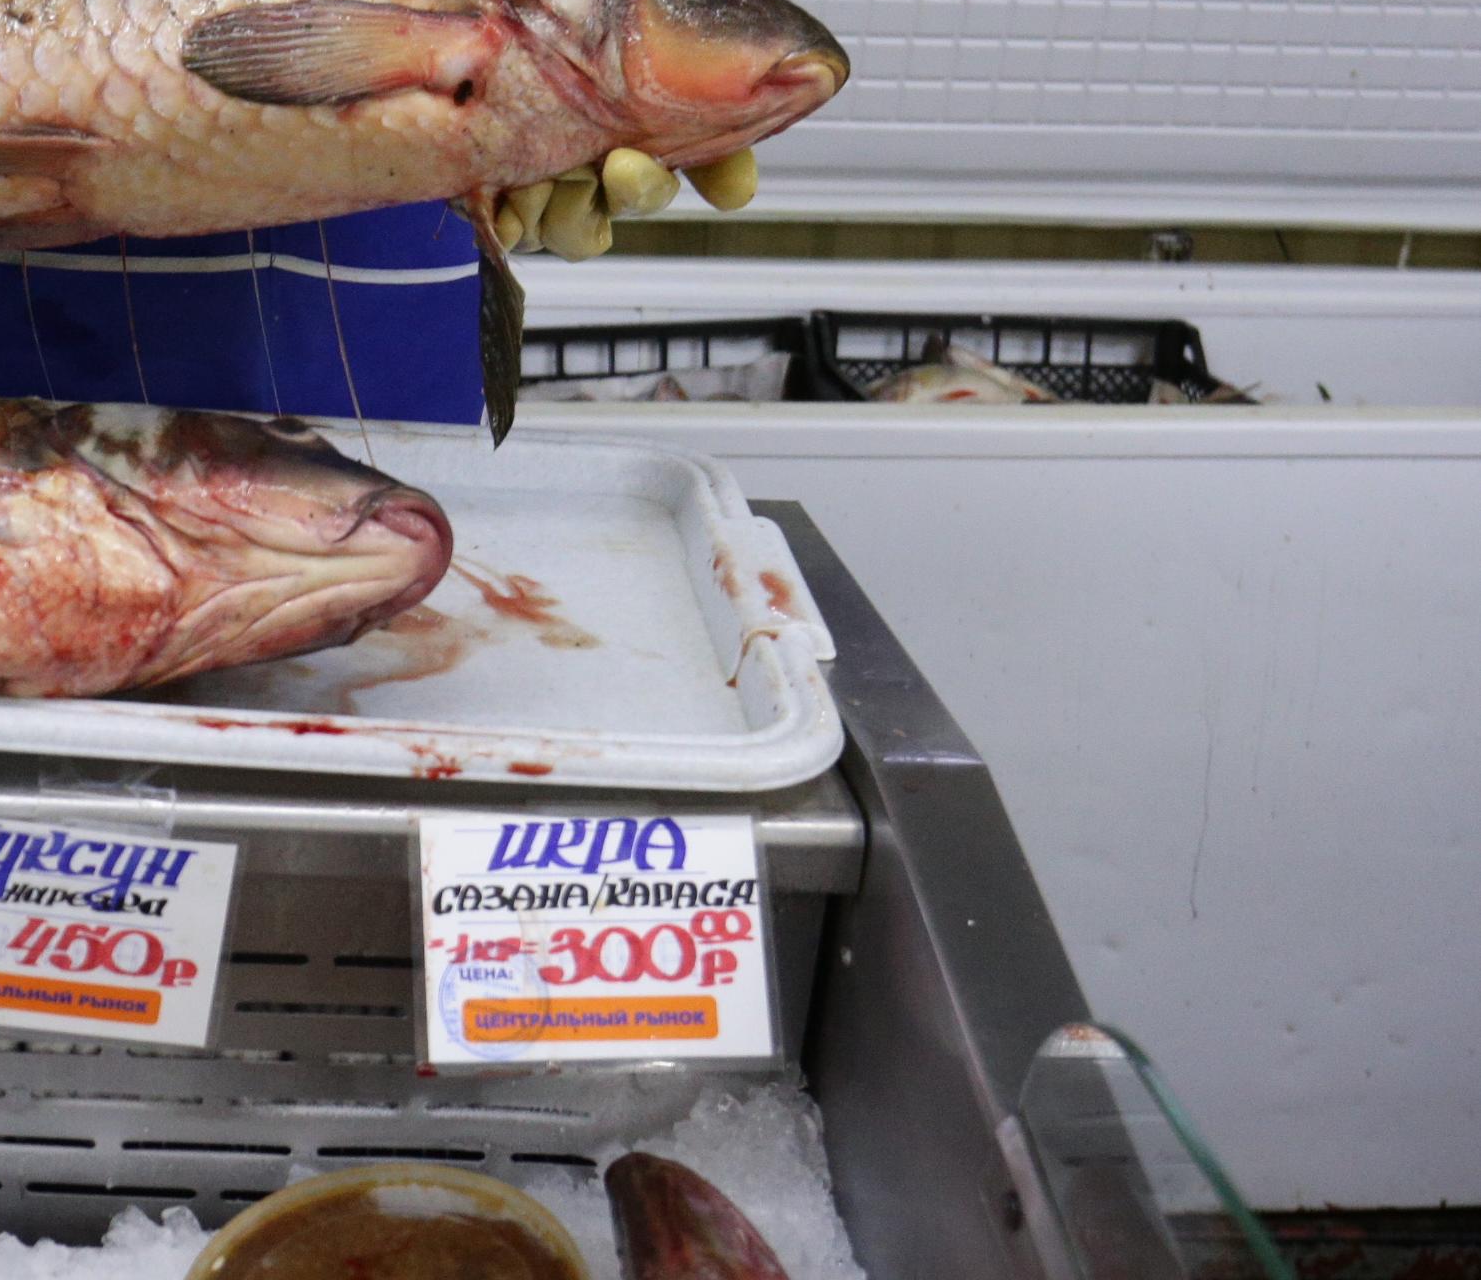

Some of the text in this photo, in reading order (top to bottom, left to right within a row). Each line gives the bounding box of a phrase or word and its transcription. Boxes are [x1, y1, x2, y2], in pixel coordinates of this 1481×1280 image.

[487, 816, 687, 875] ИКРА
[77, 994, 148, 1014] РЫНОК
[474, 1010, 706, 1029] ЦЕНТРАЛЬНЫЙ РЫНОК
